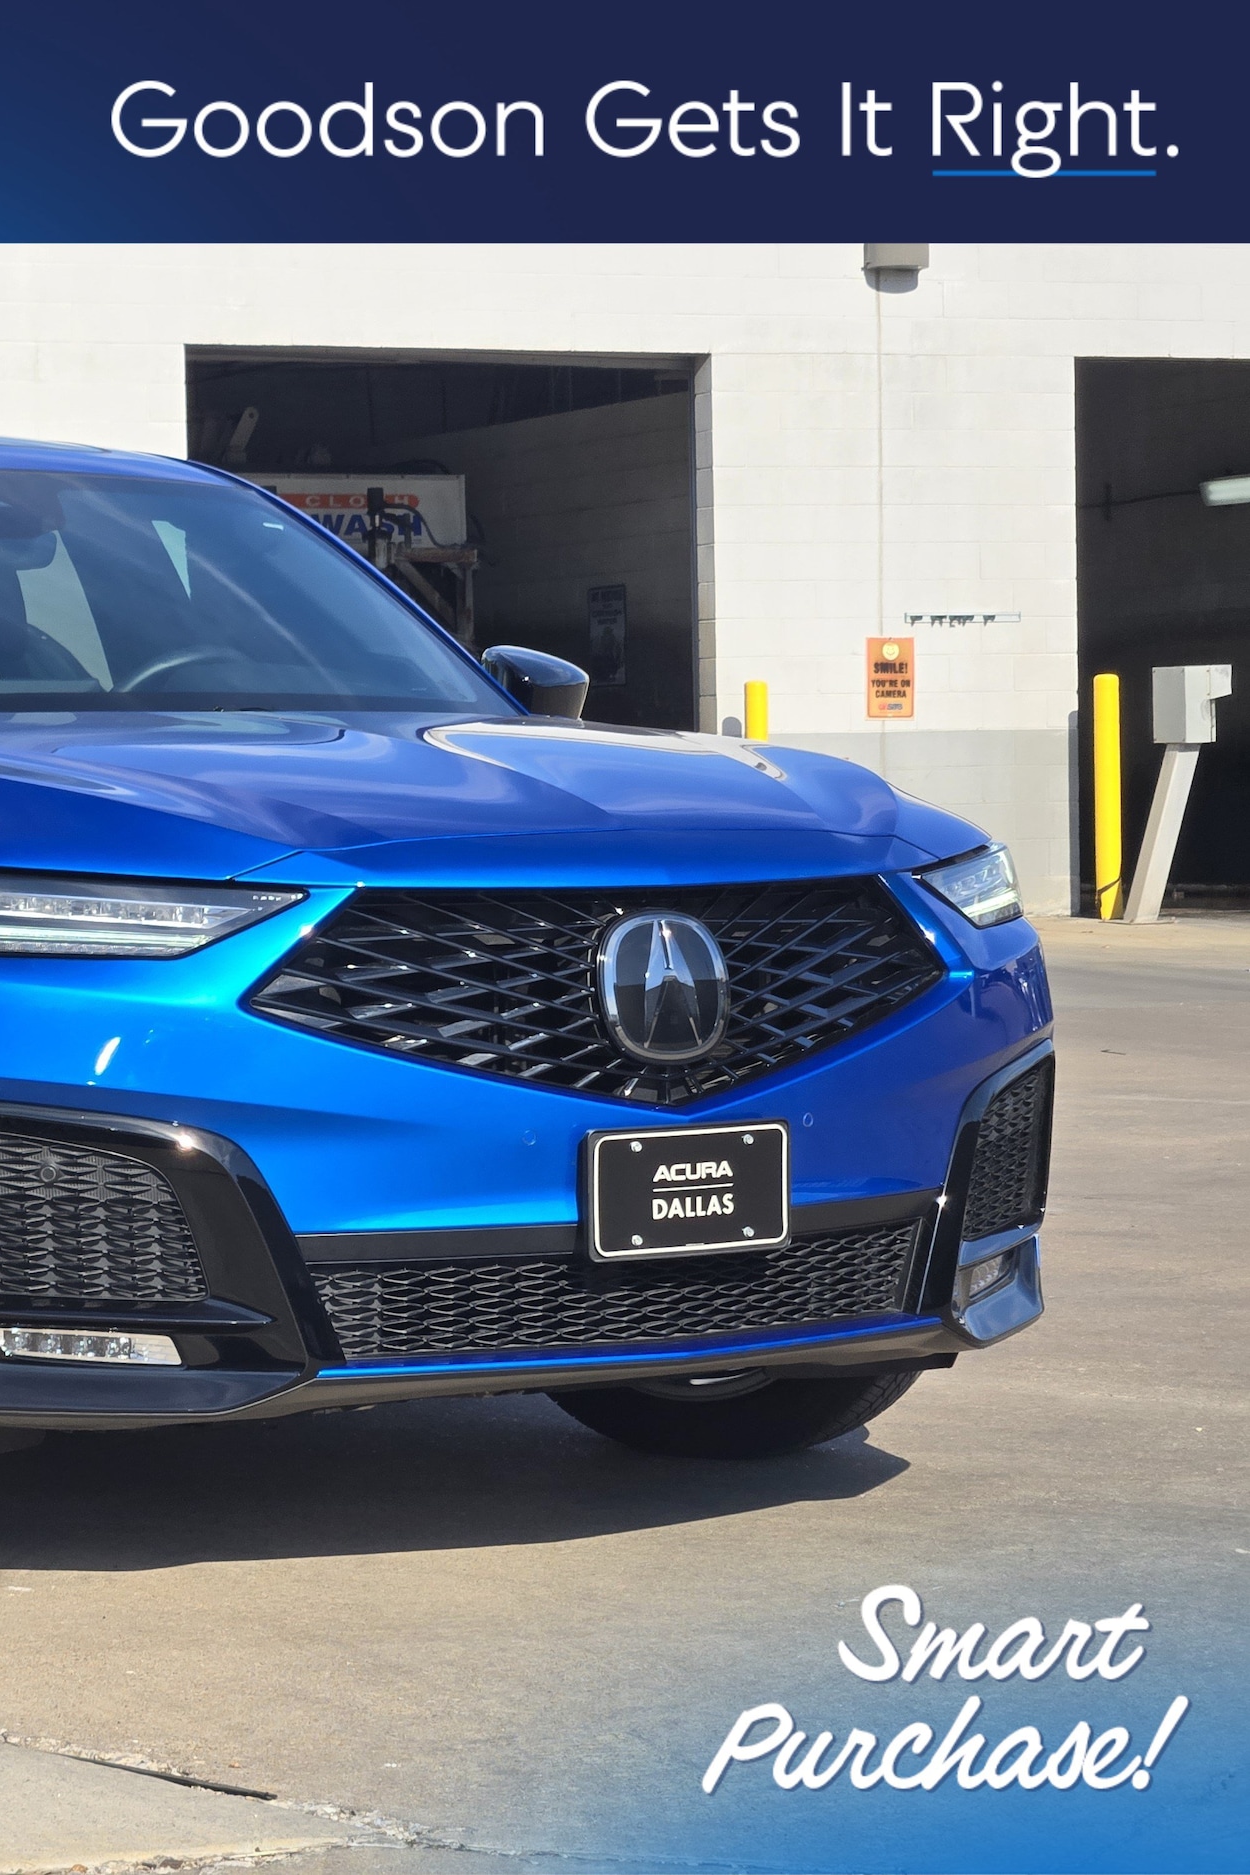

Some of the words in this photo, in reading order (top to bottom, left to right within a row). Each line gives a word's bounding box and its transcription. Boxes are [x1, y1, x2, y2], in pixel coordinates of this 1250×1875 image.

[305, 495, 409, 507] CLOH
[873, 662, 908, 674] SMILE!
[871, 679, 898, 688] YOU'RE
[900, 679, 911, 688] ON
[875, 689, 907, 698] CAMERA
[652, 1160, 734, 1182] ACURA
[652, 1193, 735, 1220] DALLAS
